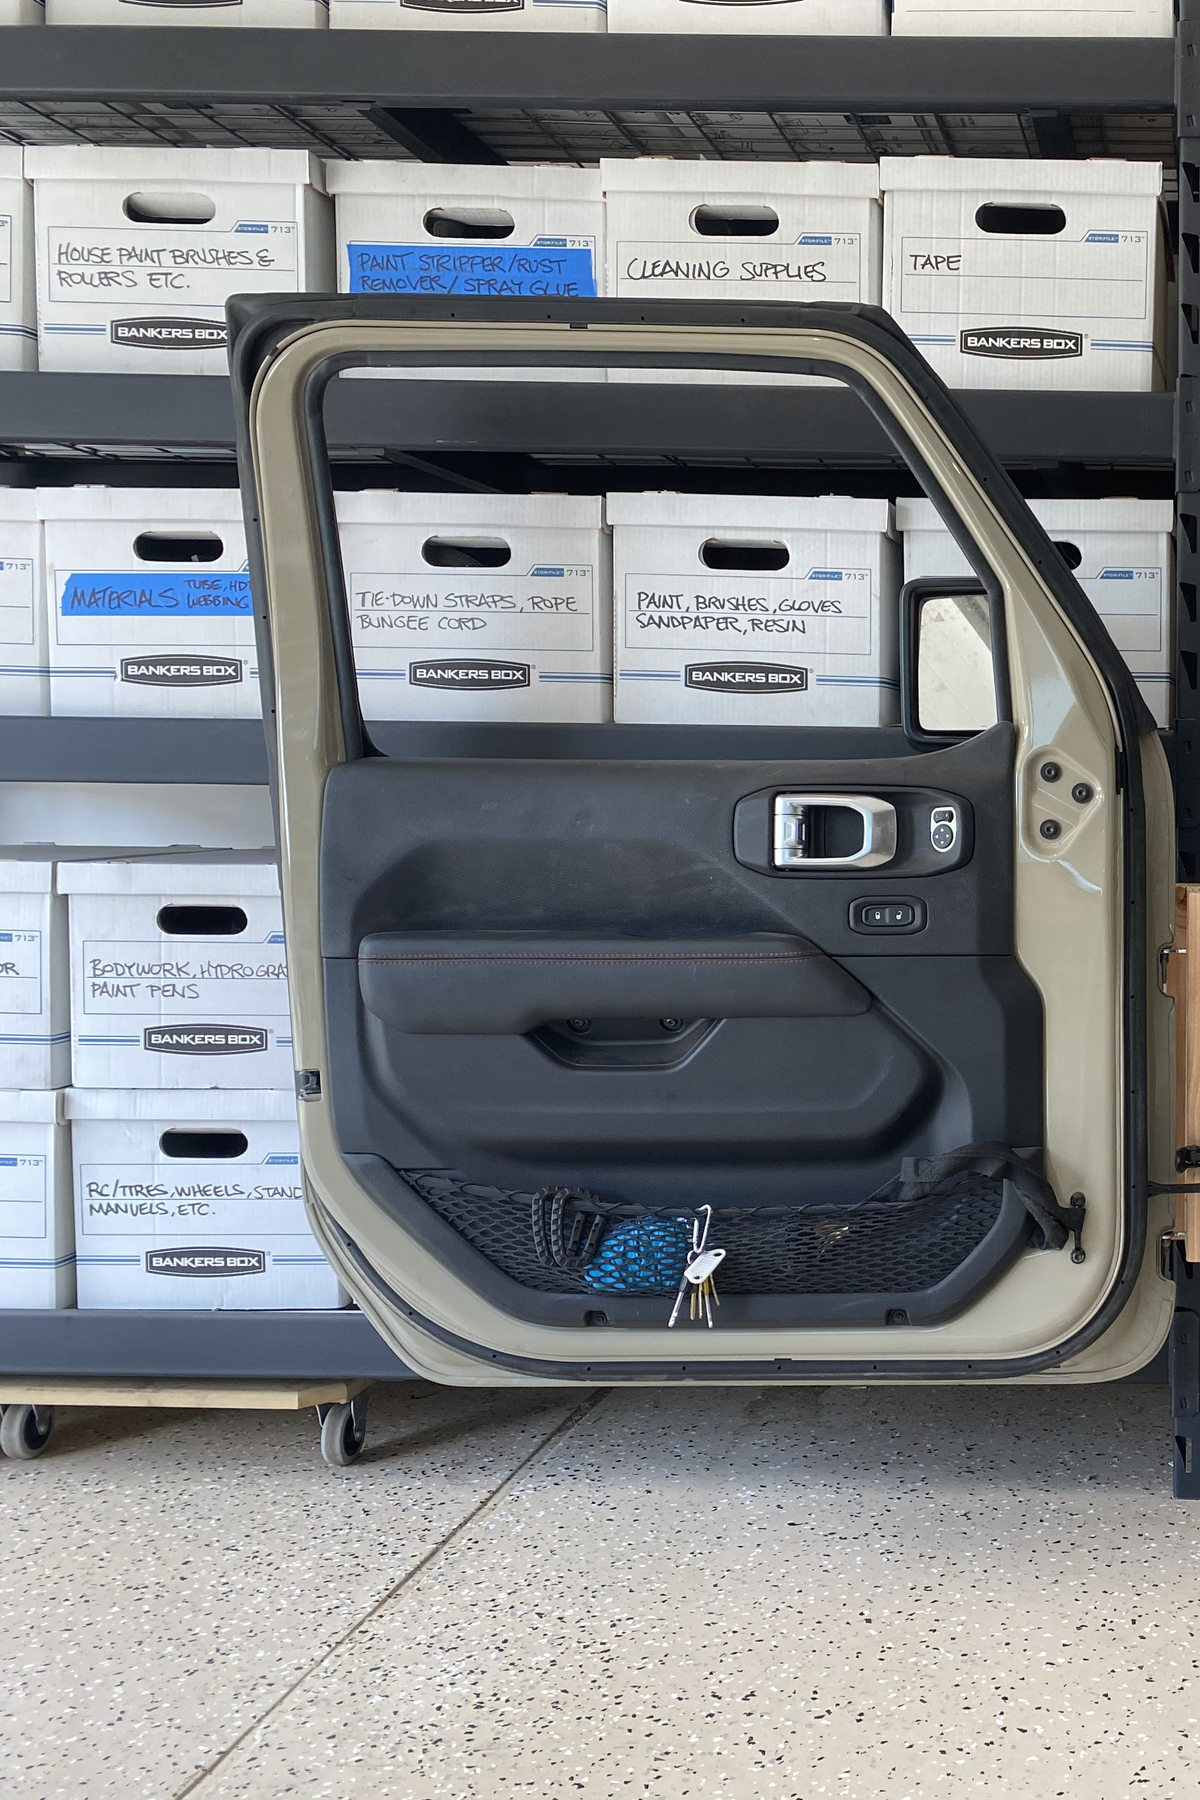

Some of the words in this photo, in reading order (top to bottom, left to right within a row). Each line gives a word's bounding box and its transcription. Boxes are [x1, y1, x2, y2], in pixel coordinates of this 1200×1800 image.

[57, 243, 113, 264] HOUSE
[117, 246, 166, 267] PAINT
[169, 248, 253, 266] BRUSHES
[255, 248, 275, 267] &
[357, 251, 414, 272] PAINT
[909, 254, 962, 271] TAPE
[627, 258, 730, 281] CLEANING
[740, 261, 827, 282] SUPPLIES
[56, 269, 138, 288] ROLLERS
[147, 272, 191, 289] ETC.
[464, 278, 524, 295] SPRAY
[529, 280, 579, 297] GLUE
[117, 326, 193, 339] BANKERS
[195, 328, 228, 340] BOX
[967, 336, 1041, 349] BANKERS
[1043, 338, 1077, 350] BOX
[70, 586, 180, 610] MATERIALS
[356, 591, 438, 610] TIE-DOWN
[527, 596, 578, 612] ROPE
[778, 599, 843, 614] GLOVES
[356, 614, 429, 631] BUNGEE
[437, 617, 487, 631] CORD
[750, 617, 806, 634] RESIN
[127, 665, 201, 677] BANKERS
[202, 665, 236, 676] BOX
[416, 668, 489, 679] BANKERS
[491, 669, 524, 680] BOX
[692, 670, 766, 683] BANKERS
[768, 673, 802, 684] BOX
[91, 981, 141, 999] PAINT
[146, 983, 200, 999] PENS
[151, 1034, 225, 1046] BANKERS
[227, 1034, 261, 1045] BOX
[152, 1257, 225, 1267] BANKERS
[226, 1257, 260, 1266] BOX
